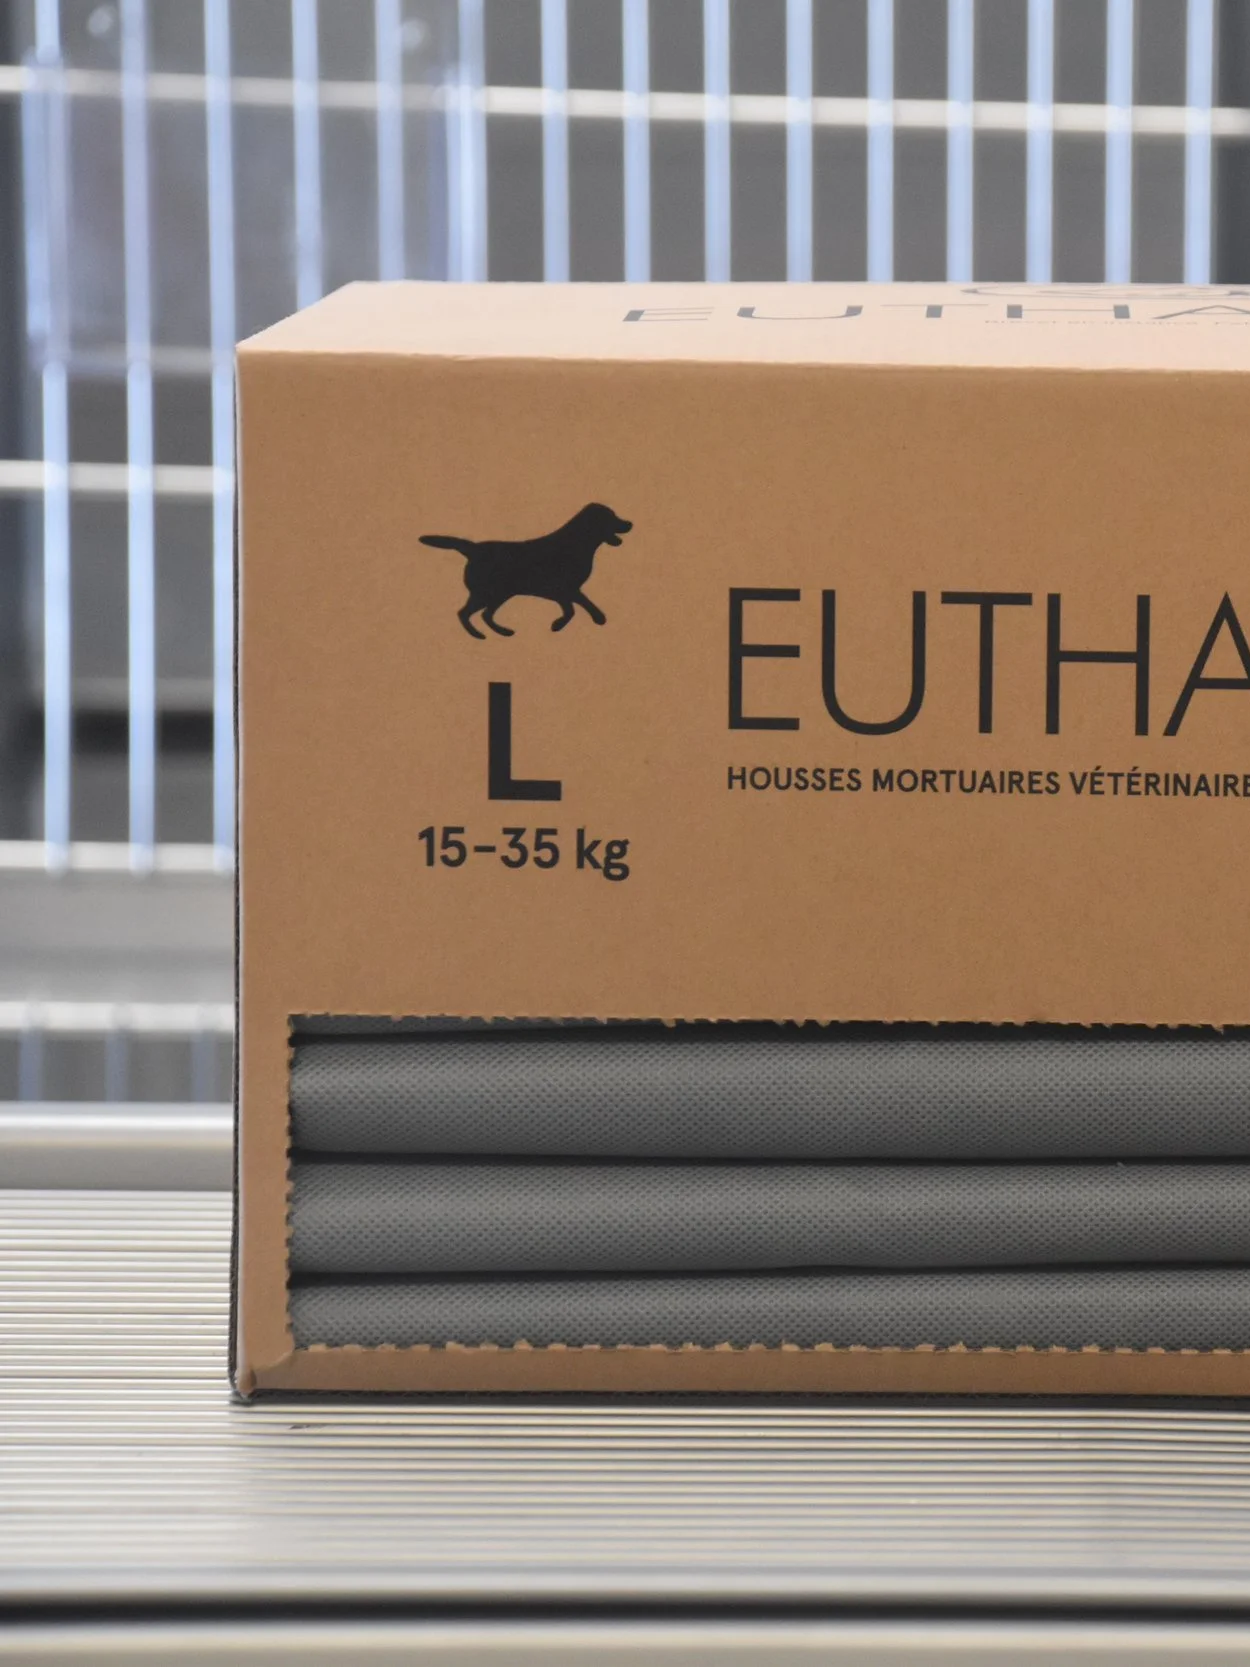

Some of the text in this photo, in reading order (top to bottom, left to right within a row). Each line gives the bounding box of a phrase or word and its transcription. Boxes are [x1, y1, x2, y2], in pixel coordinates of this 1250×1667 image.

[487, 681, 562, 802] L
[727, 766, 862, 792] HOUSSES
[872, 768, 1061, 795] MORTUAIRES
[575, 827, 630, 882] kg
